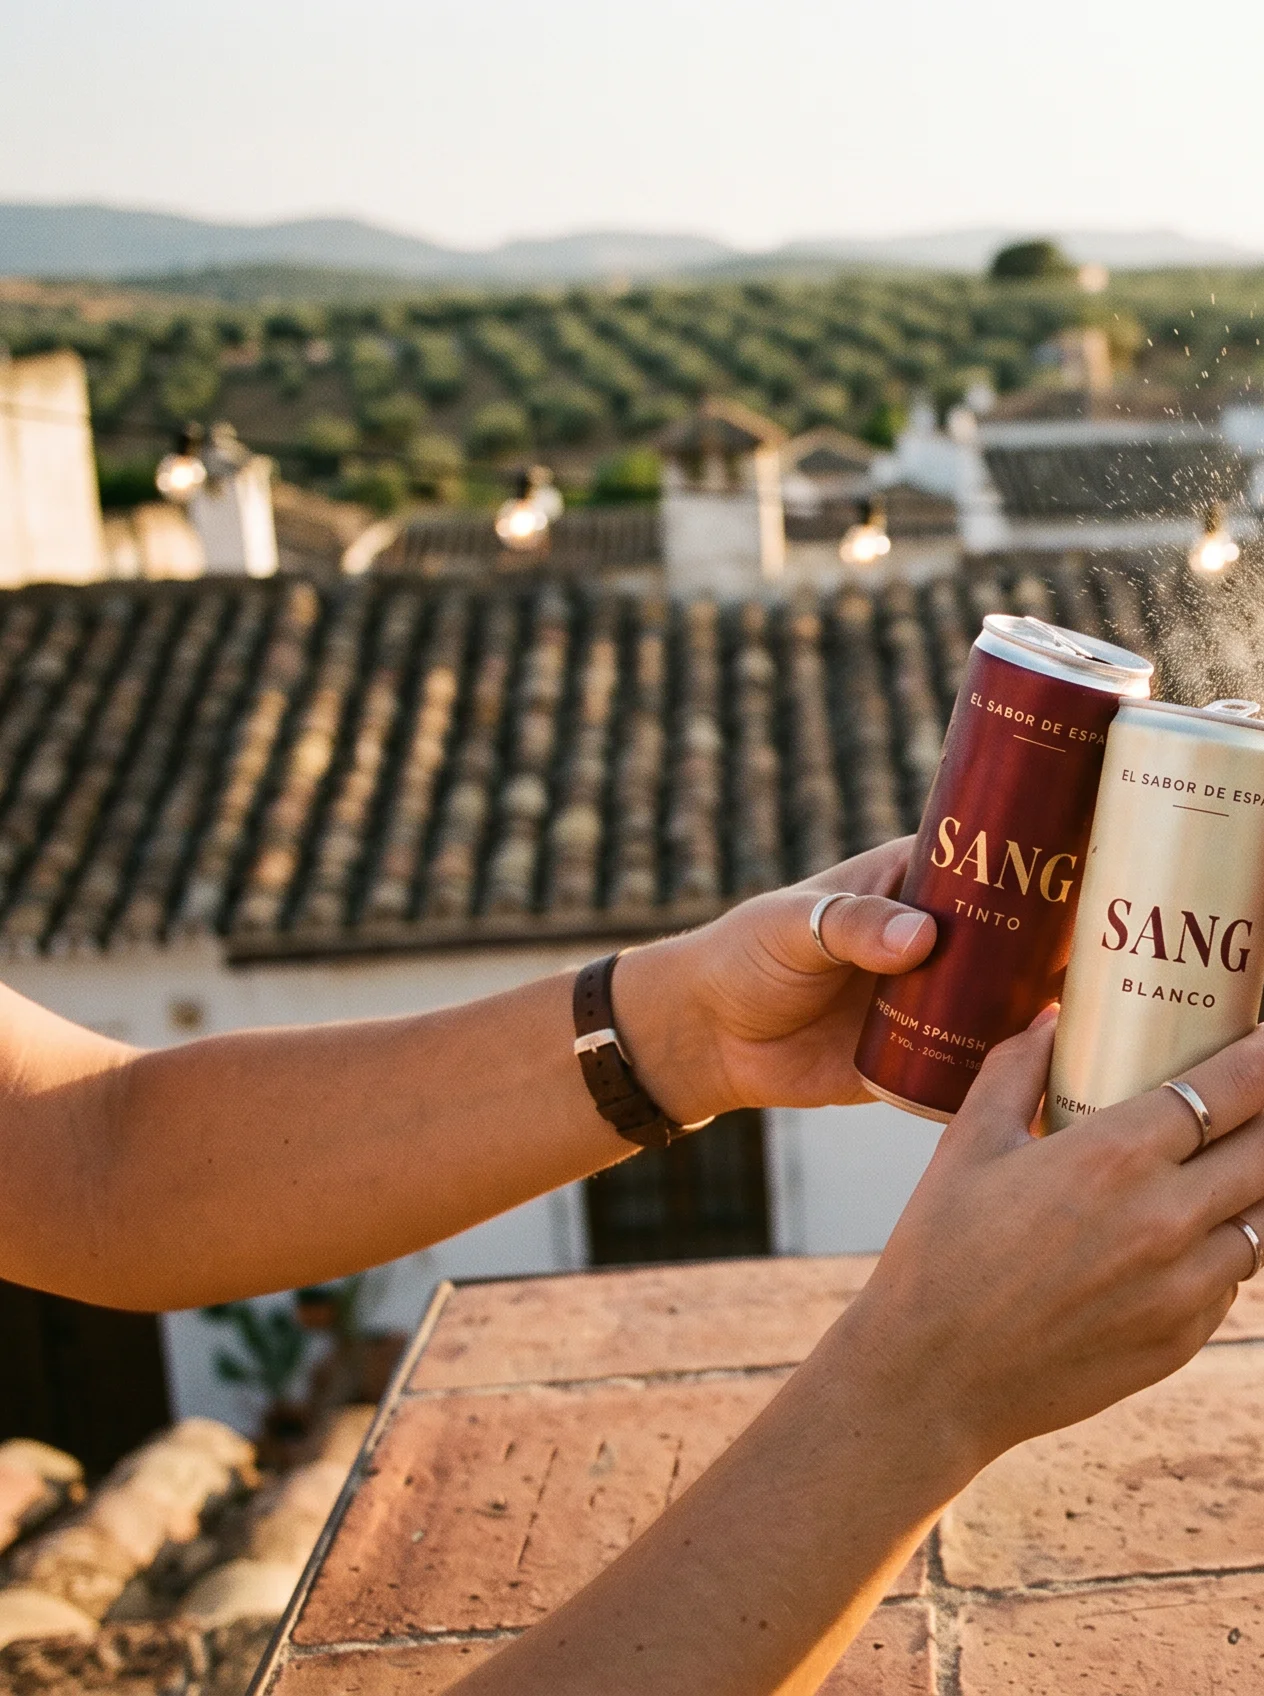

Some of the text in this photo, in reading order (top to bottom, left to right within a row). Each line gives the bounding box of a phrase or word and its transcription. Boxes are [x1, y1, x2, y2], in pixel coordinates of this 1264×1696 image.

[970, 692, 1106, 746] EL SABOR DE ESPA
[1121, 769, 1136, 783] EL
[1141, 773, 1197, 794] SABOR
[1204, 785, 1227, 800] DE
[930, 816, 1078, 903] SANG
[954, 898, 1021, 931] TINTO
[1101, 898, 1253, 973] SANG
[1121, 977, 1216, 1008] BLANCO
[899, 1035, 914, 1051] VOL
[922, 1024, 987, 1052] SPANISH
[1056, 1094, 1096, 1115] PREMI
